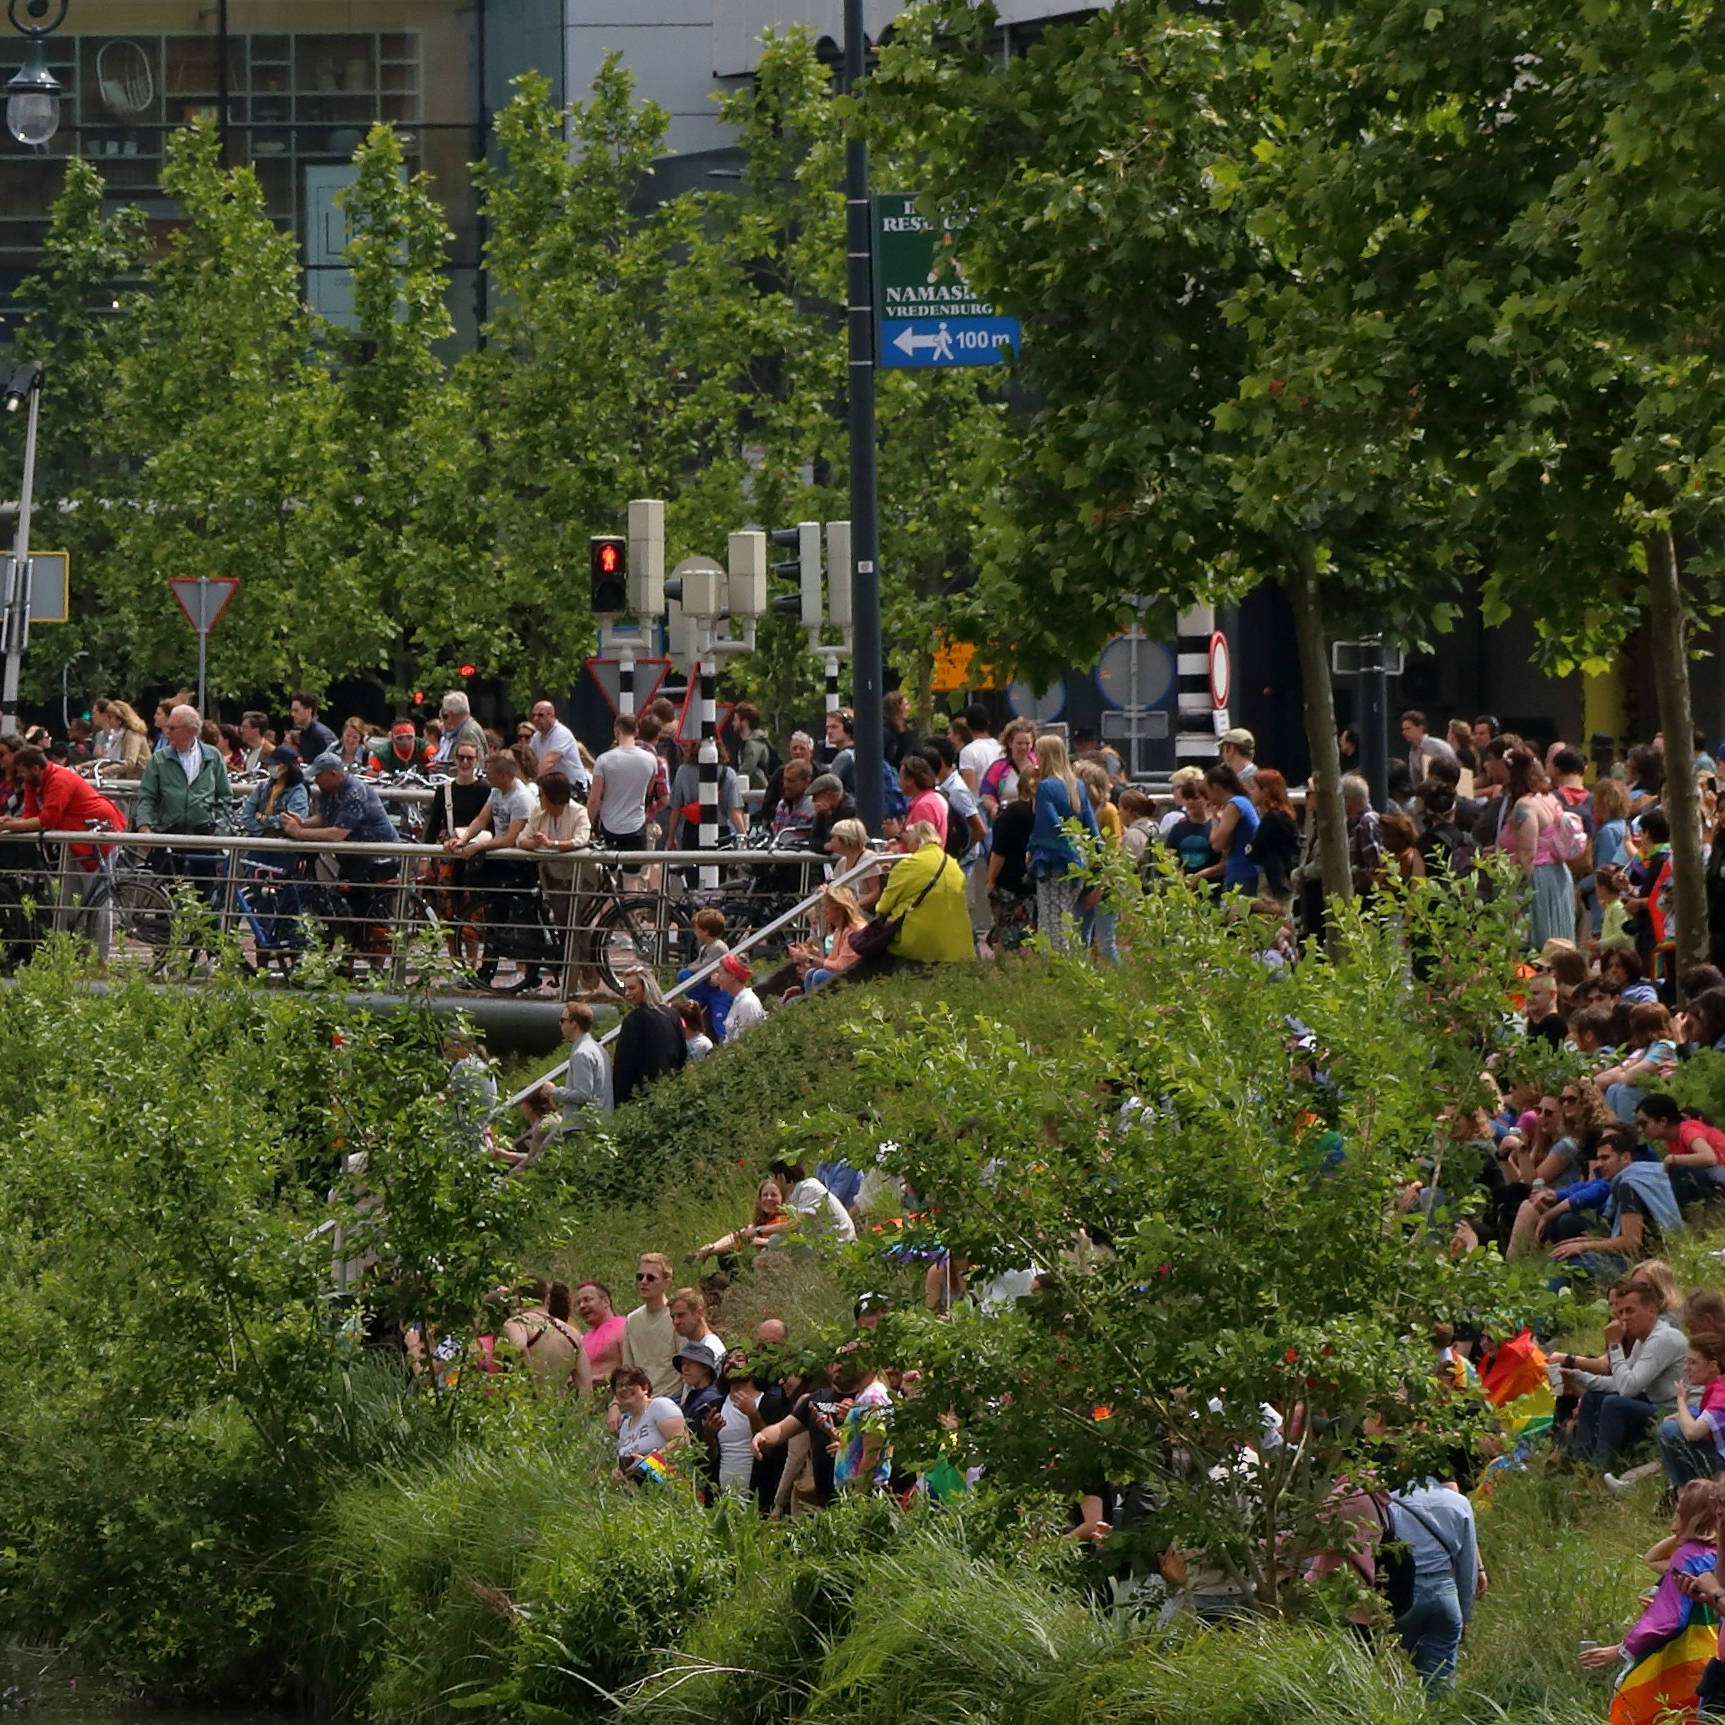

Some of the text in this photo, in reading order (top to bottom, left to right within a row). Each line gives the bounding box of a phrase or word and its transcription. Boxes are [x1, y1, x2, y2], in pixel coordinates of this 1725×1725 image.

[885, 303, 993, 317] VREDENBURG
[955, 330, 1010, 349] 100 m
